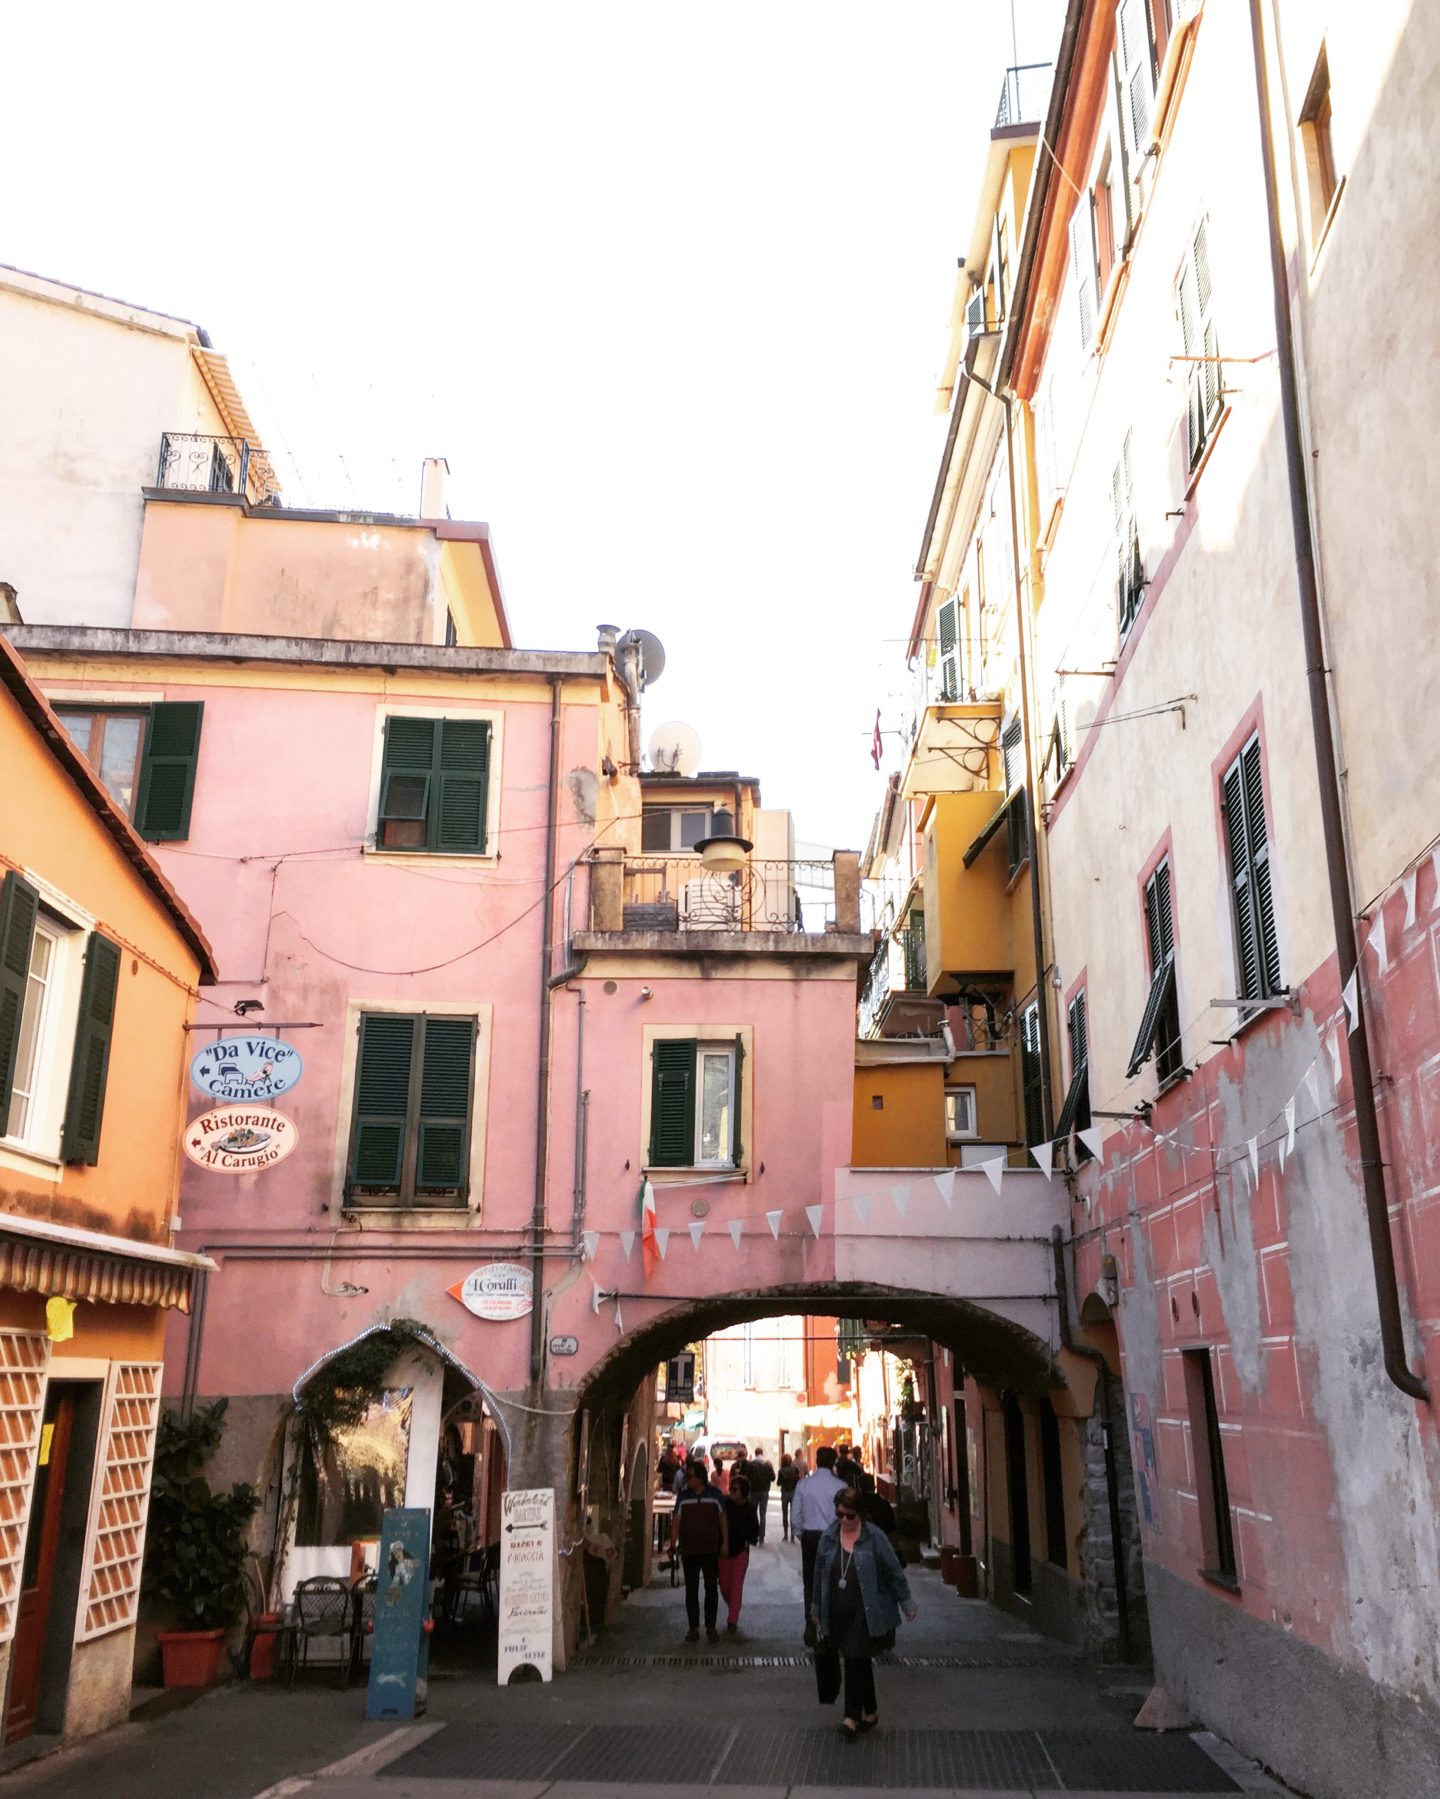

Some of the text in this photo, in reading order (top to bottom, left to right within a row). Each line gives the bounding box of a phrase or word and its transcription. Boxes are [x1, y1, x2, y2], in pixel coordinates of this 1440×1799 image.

[205, 1041, 294, 1063] "Da Vice"
[208, 1077, 286, 1099] Camere
[199, 1113, 286, 1135] Ristorante
[199, 1143, 281, 1168] "Al Carugio"
[479, 1278, 517, 1293] Coralli
[503, 1492, 552, 1517] Wonderland
